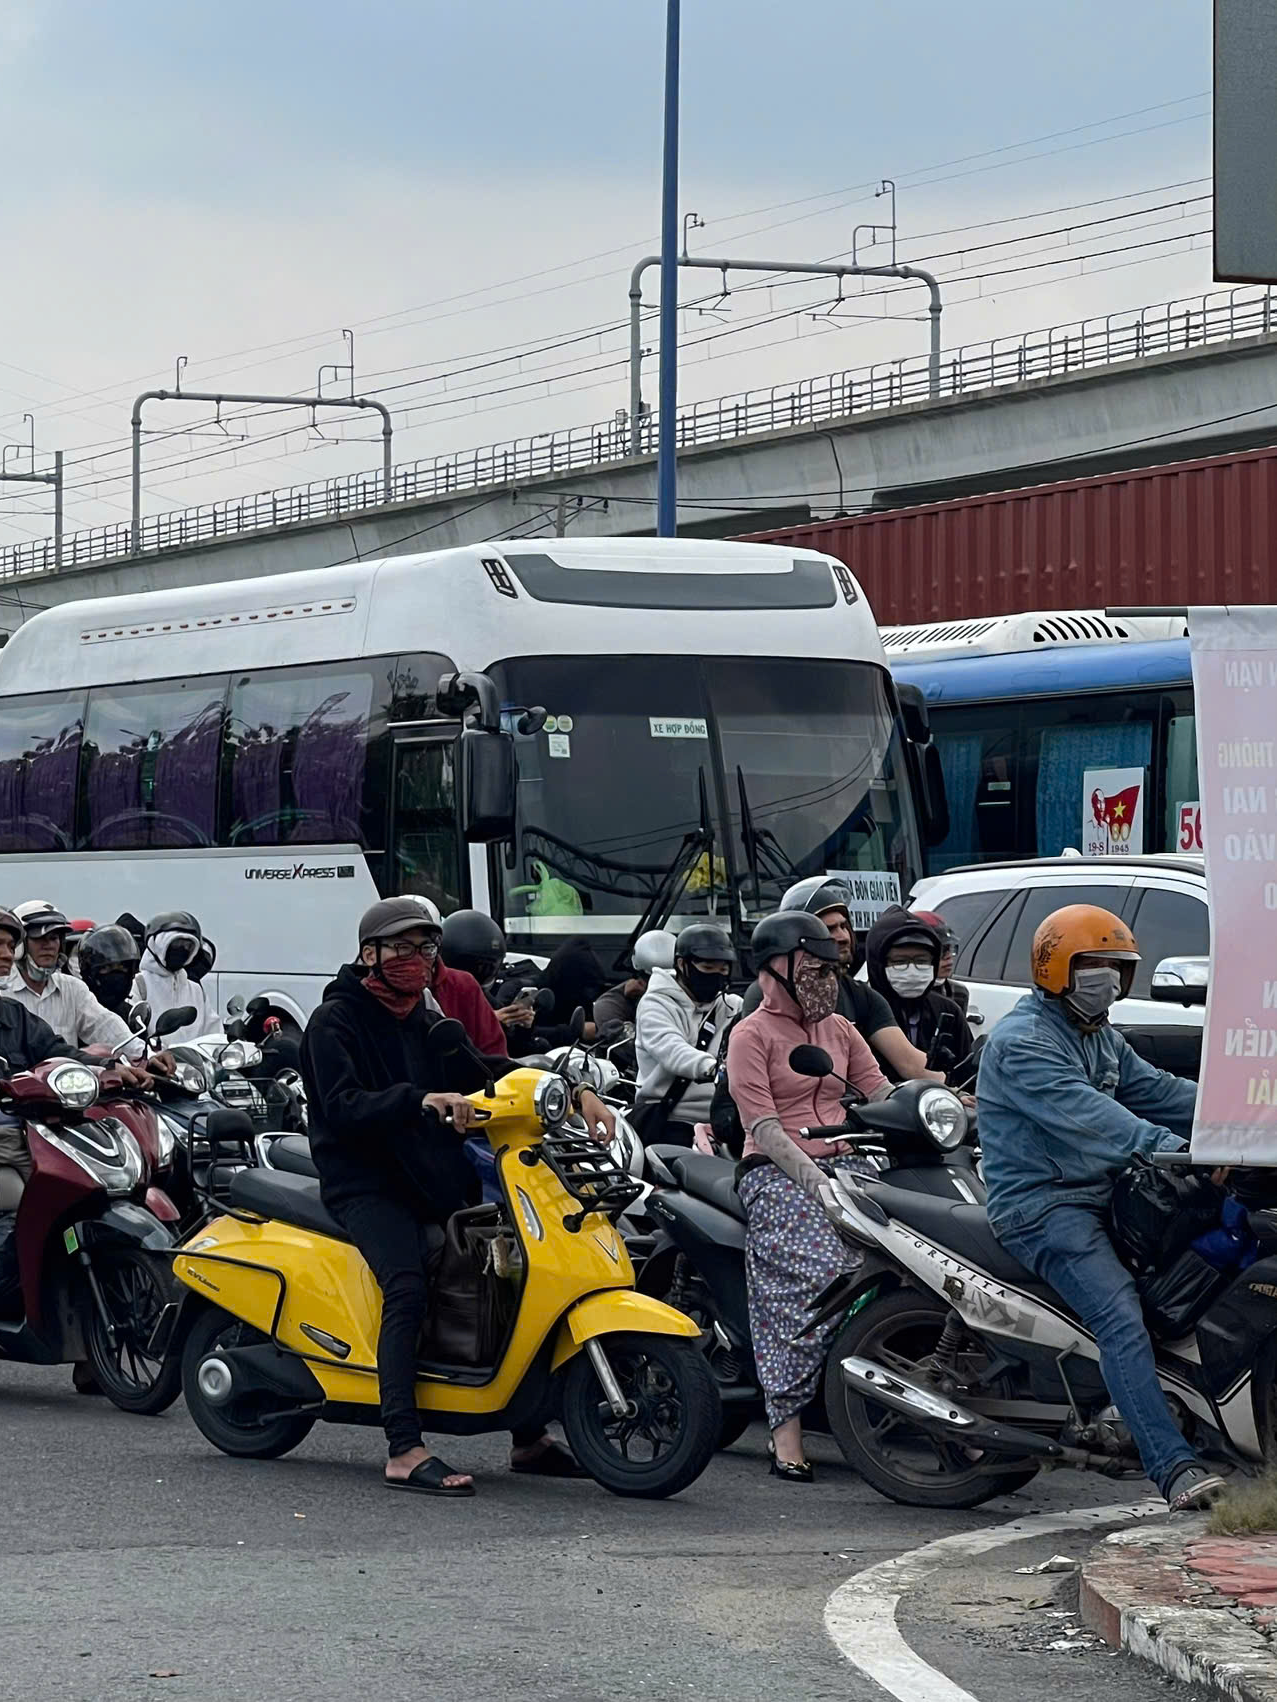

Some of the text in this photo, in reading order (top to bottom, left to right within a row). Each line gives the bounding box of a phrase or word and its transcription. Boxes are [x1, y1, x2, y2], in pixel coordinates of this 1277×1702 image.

[653, 724, 664, 734] XE
[666, 723, 683, 735] HỢP
[913, 1240, 1006, 1298] GRAVITA
